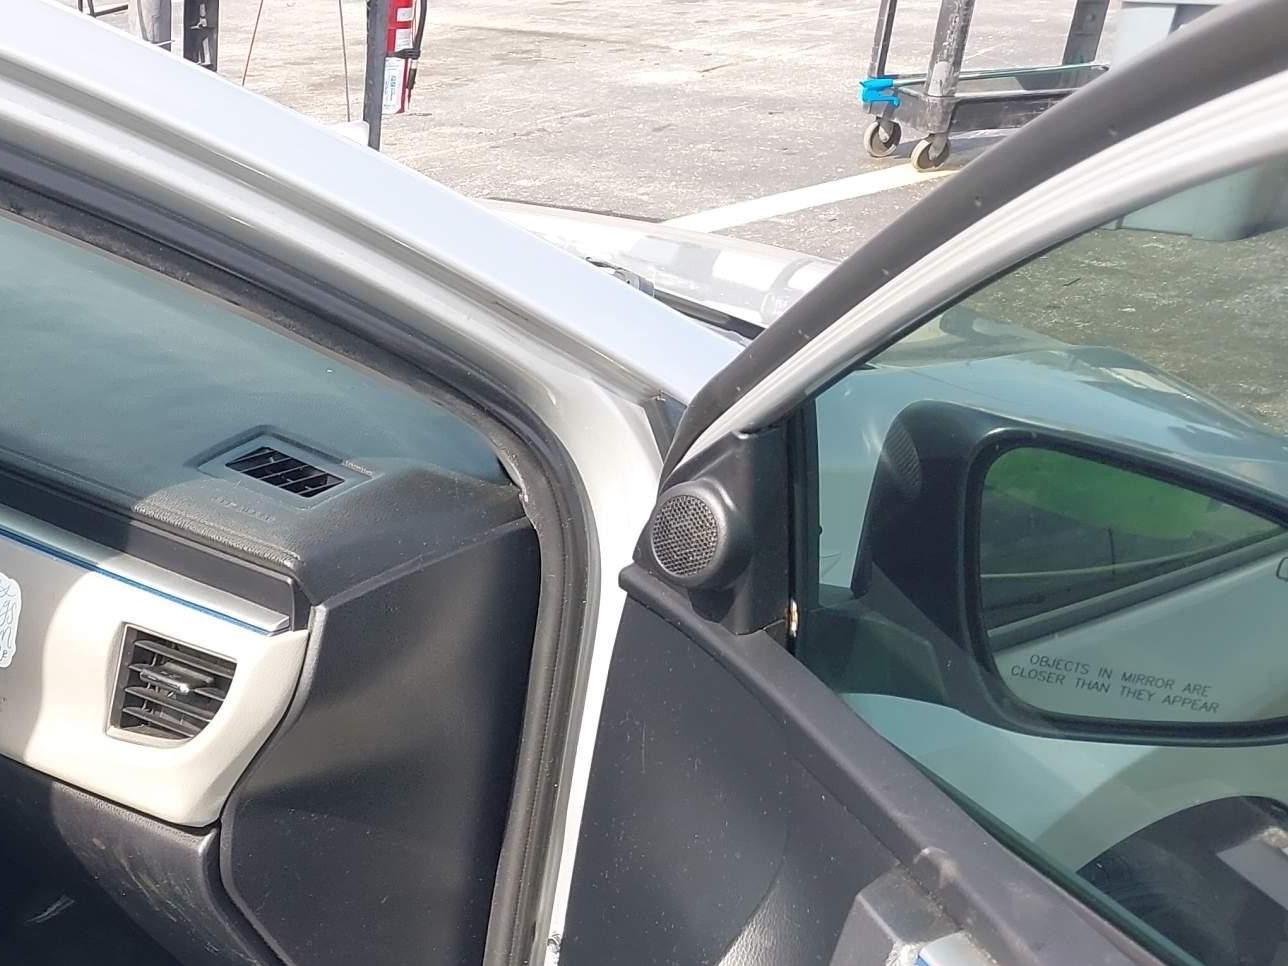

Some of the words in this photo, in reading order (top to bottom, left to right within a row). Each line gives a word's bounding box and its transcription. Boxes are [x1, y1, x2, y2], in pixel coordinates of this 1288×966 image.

[1011, 664, 1065, 685] CLOSER
[1075, 678, 1111, 693] THAN
[1120, 686, 1155, 702] THEY
[1161, 695, 1220, 713] APPEAR
[1030, 654, 1090, 675] OBJECTS
[1098, 667, 1112, 679] IN
[1121, 671, 1175, 690] MIRROR
[1182, 683, 1211, 698] ARE
